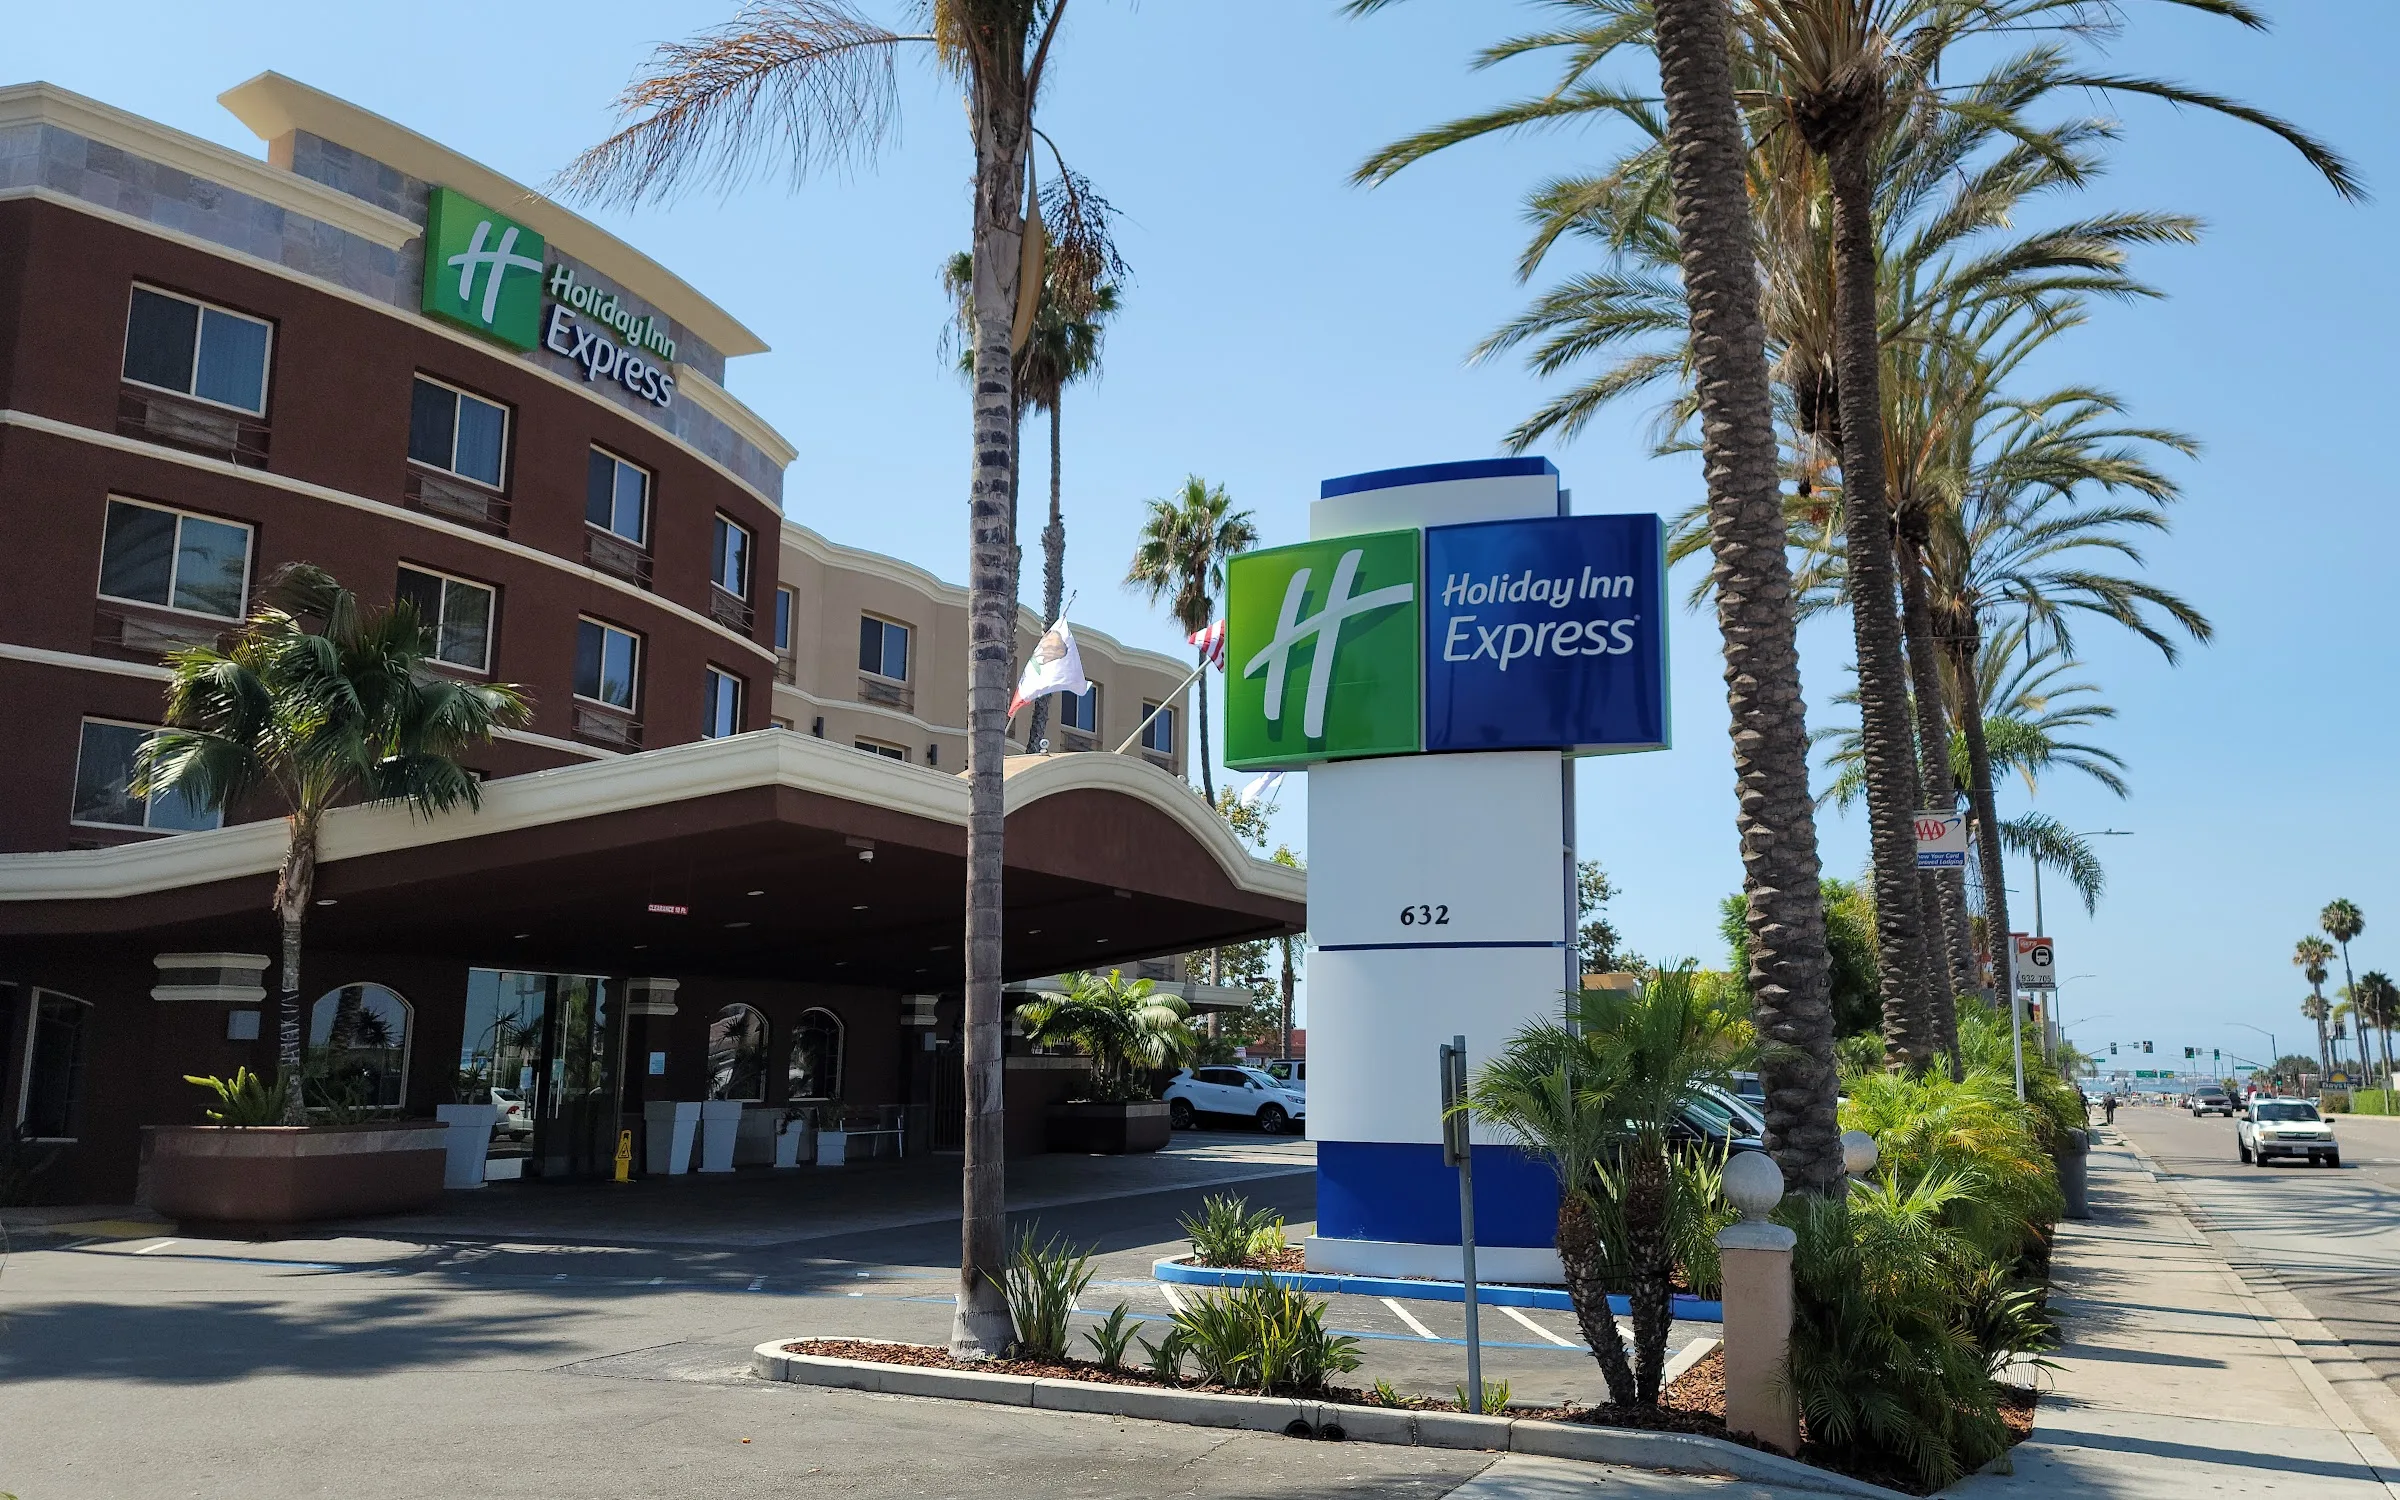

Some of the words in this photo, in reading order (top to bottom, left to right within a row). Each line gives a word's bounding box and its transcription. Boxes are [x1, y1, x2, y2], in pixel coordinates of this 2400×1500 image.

[549, 264, 644, 347] Holiday
[643, 316, 676, 361] Inn
[547, 303, 674, 408] Express
[1441, 569, 1574, 608] Holiday
[1579, 565, 1635, 599] Inn
[1443, 614, 1636, 671] Express
[1400, 904, 1450, 925] 632
